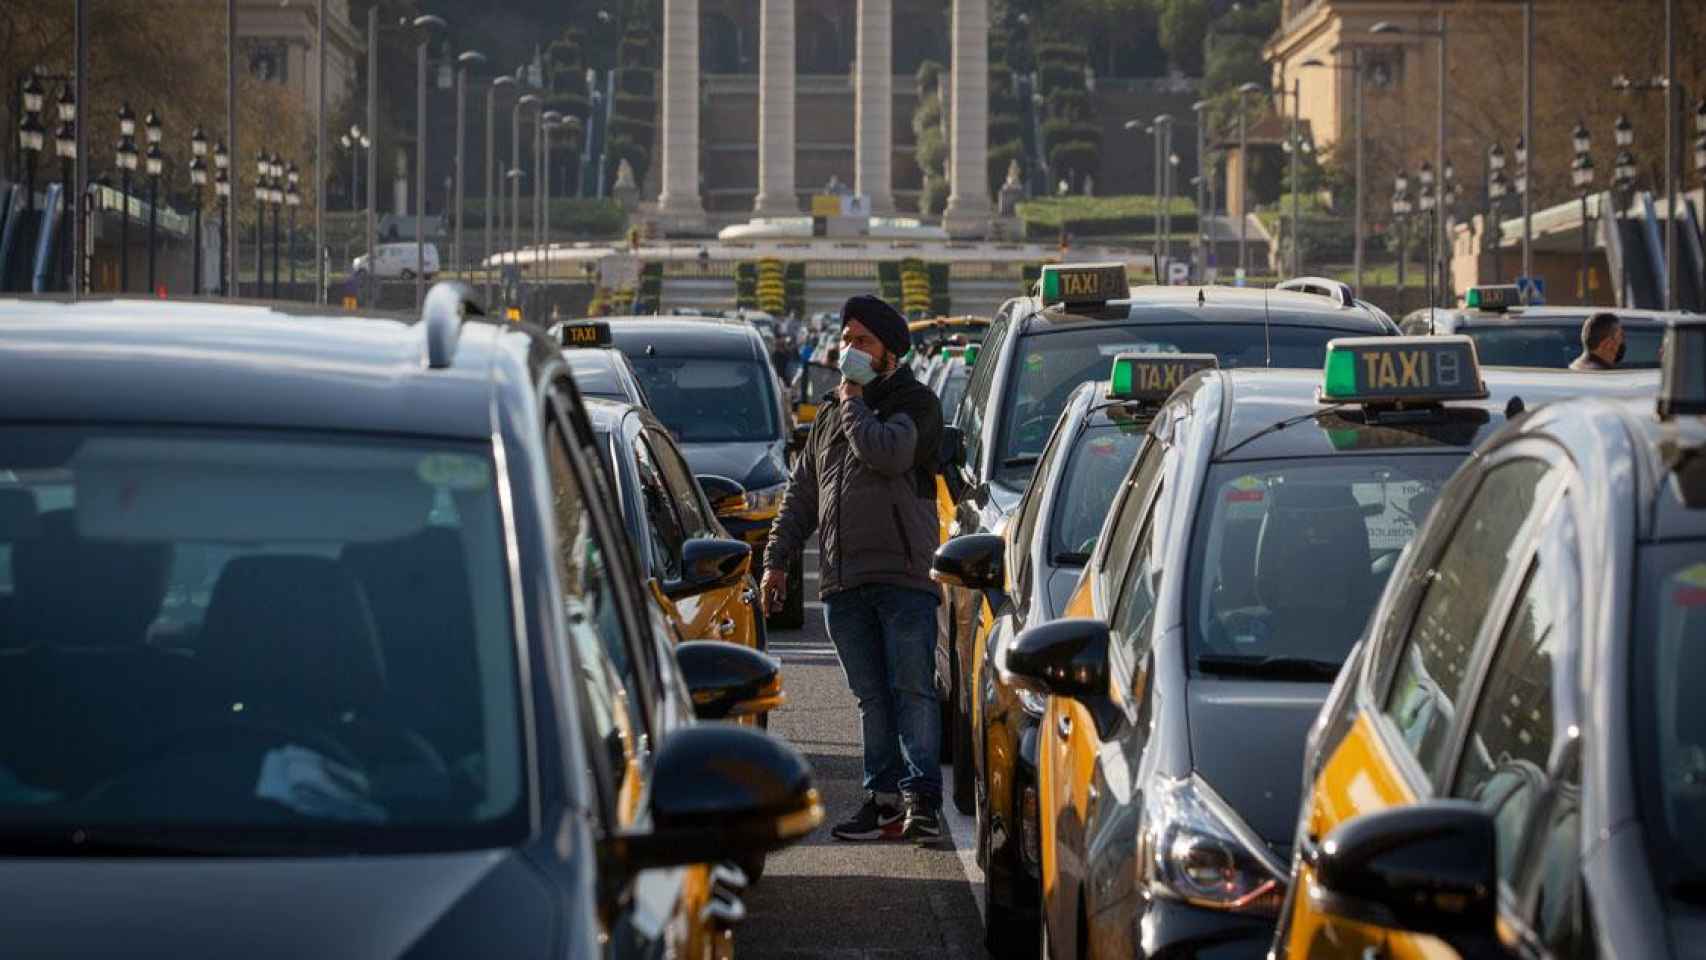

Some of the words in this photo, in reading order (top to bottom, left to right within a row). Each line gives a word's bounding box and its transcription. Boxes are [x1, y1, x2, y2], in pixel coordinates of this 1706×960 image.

[1060, 273, 1098, 295] TAXI
[569, 327, 596, 342] TAXI
[1135, 363, 1185, 391] TAXI
[1361, 350, 1431, 389] TAXI
